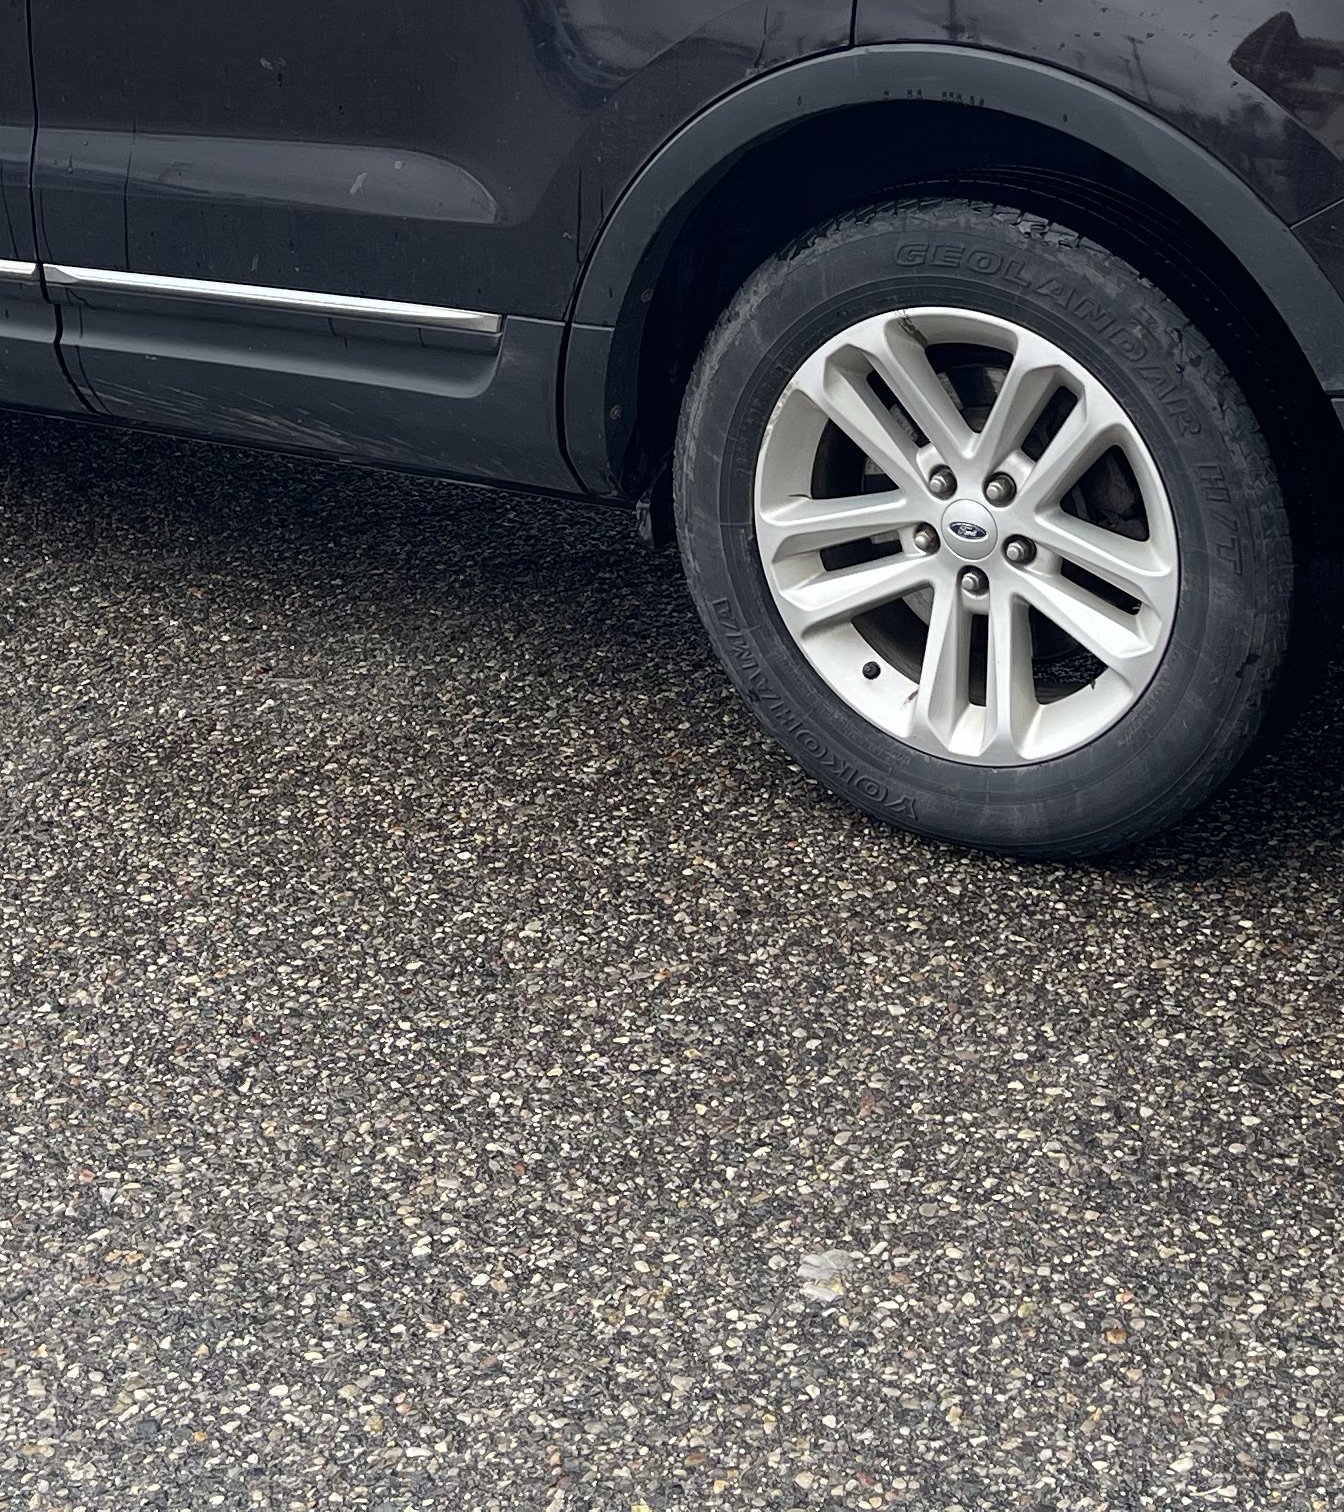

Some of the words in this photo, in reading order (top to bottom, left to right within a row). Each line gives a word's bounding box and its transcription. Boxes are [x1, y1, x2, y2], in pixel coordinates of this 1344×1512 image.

[894, 240, 1203, 440] GEOLANDAR
[1195, 462, 1246, 576] H/T
[711, 596, 919, 822] YOKOHAMA
